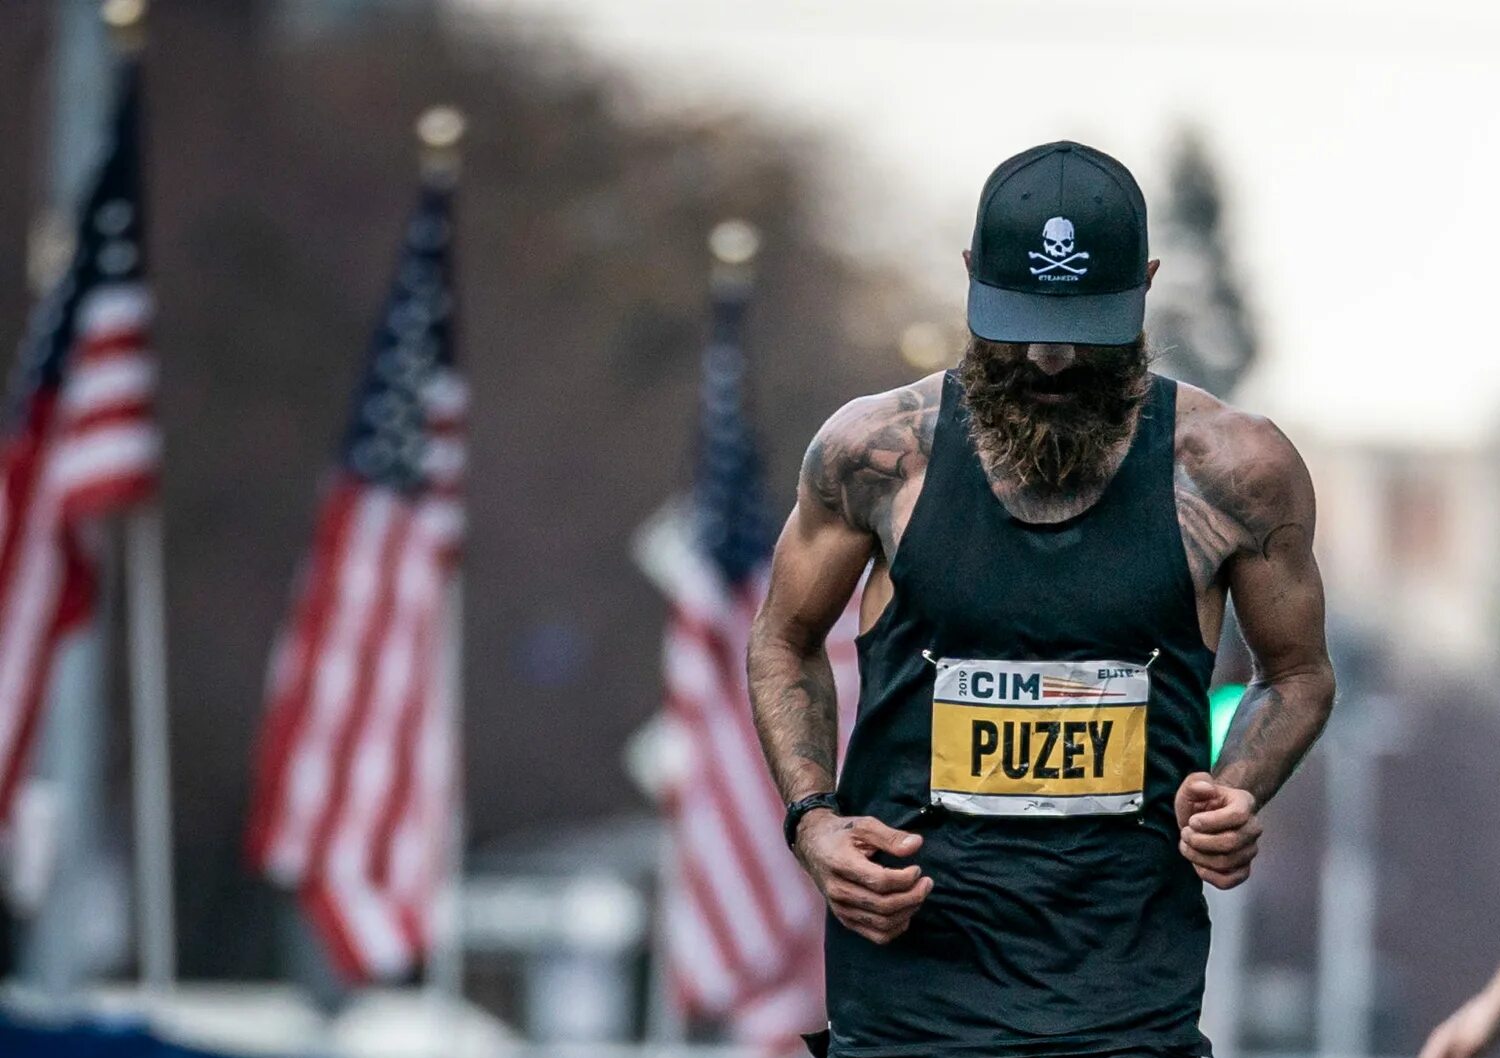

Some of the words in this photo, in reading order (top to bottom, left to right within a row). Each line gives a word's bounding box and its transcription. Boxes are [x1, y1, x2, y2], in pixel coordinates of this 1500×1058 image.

[959, 670, 968, 697] 2019
[970, 671, 1041, 701] CIM
[1097, 668, 1134, 680] ELITE
[970, 718, 1114, 780] PUZEY
